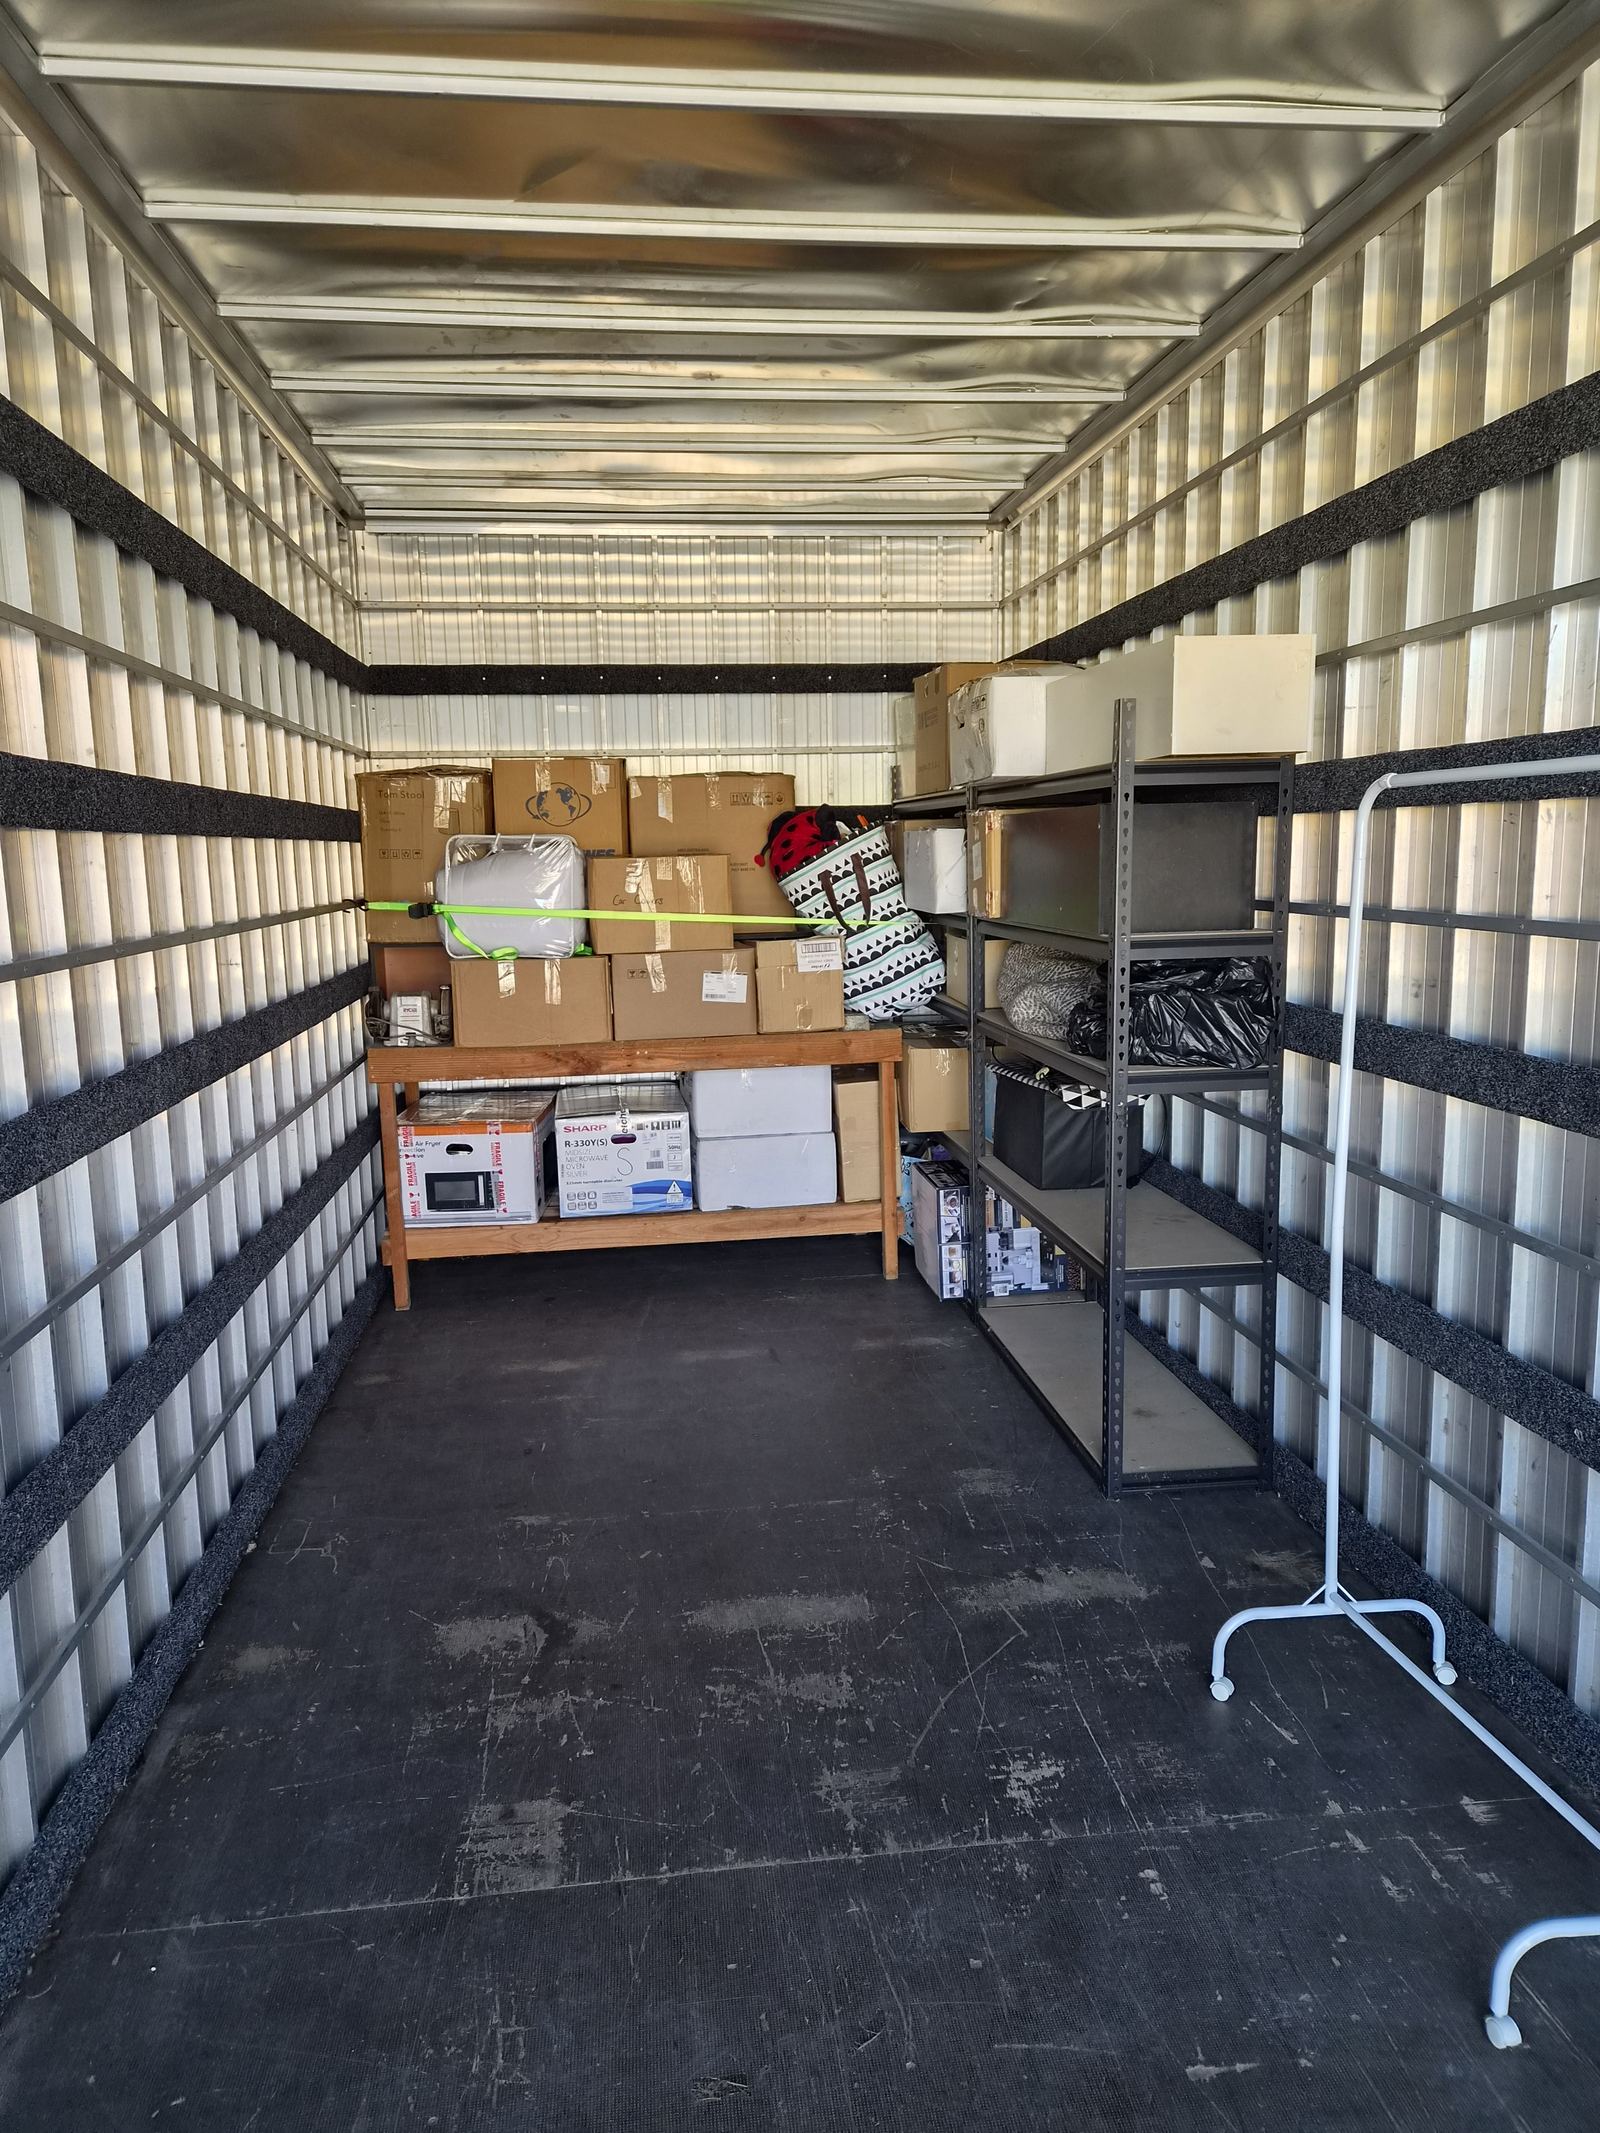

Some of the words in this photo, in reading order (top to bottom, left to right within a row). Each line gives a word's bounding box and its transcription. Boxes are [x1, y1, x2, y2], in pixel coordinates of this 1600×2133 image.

[378, 789, 398, 799] Tom
[400, 790, 425, 799] Stool
[612, 894, 627, 906] Car
[563, 1124, 607, 1133] SHARP
[402, 1126, 411, 1148] FRAGIL
[564, 1138, 608, 1148] R-330Y(S)
[494, 1141, 503, 1167] FRAGILE
[565, 1154, 609, 1163] MICROWAVE
[406, 1161, 415, 1187] FRAGILE
[497, 1180, 507, 1206] FRAGILE
